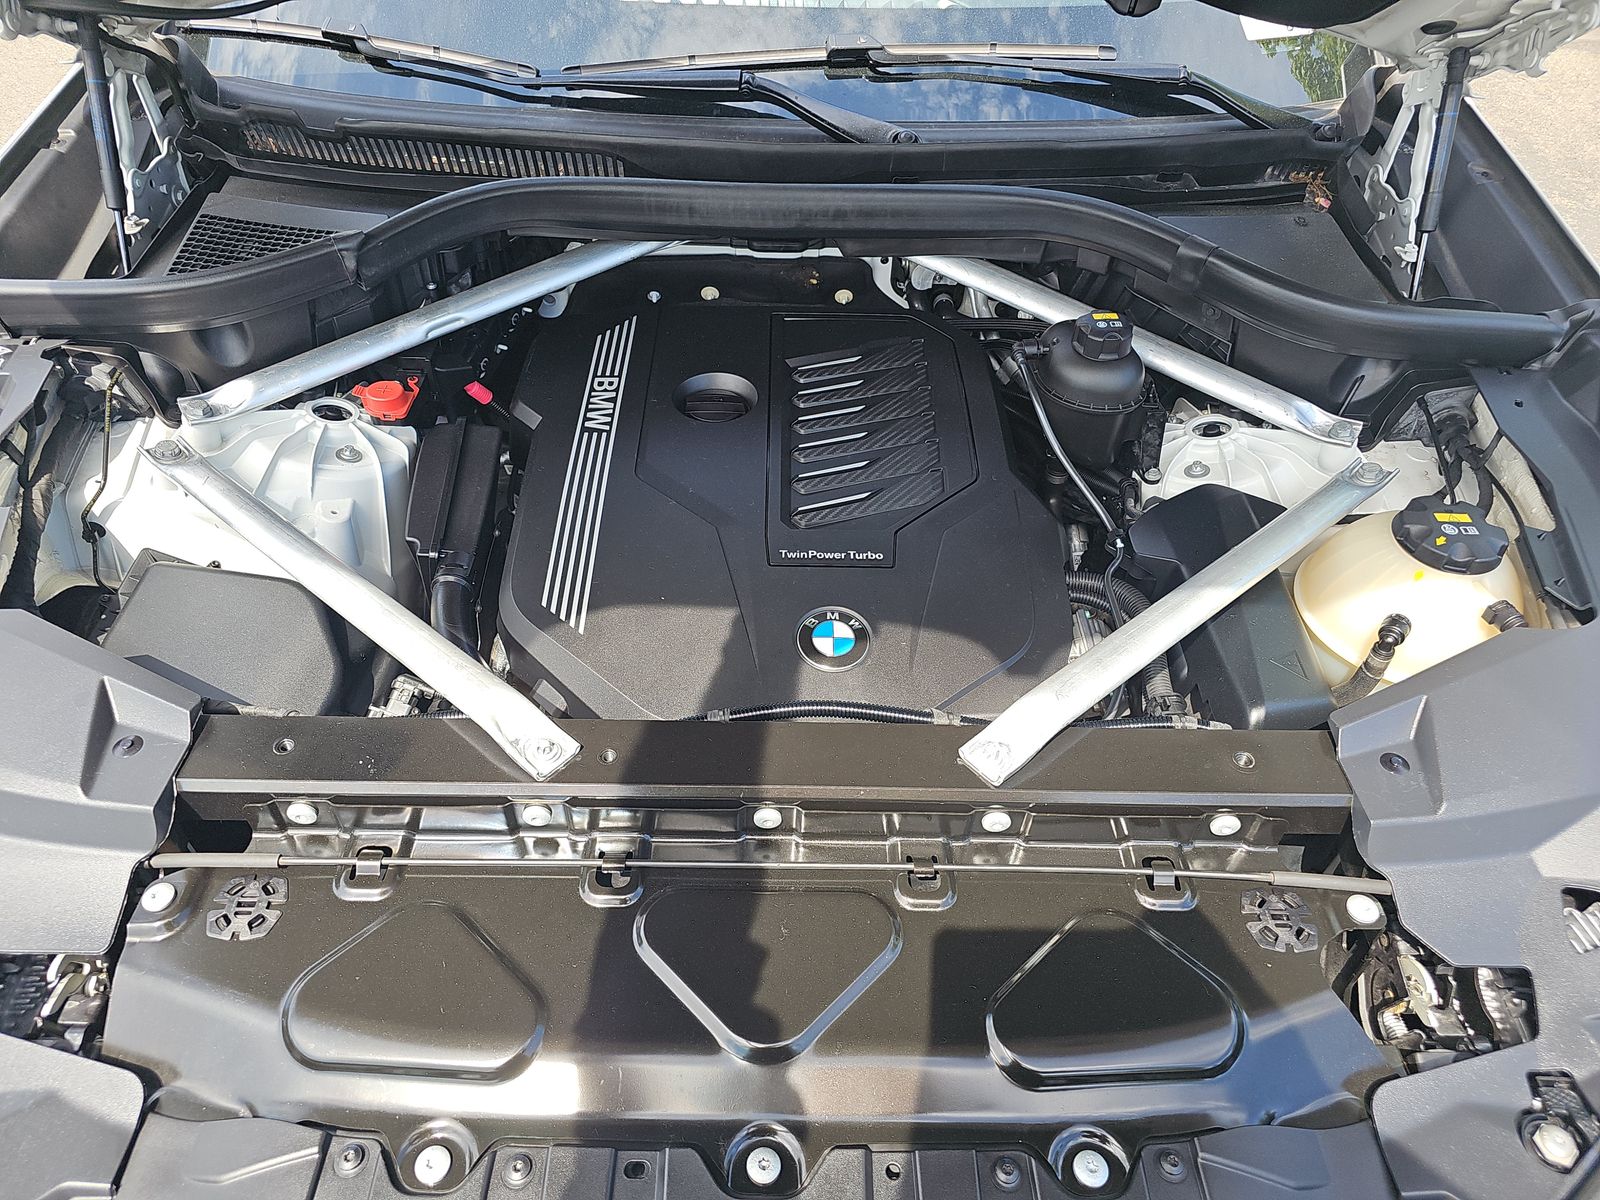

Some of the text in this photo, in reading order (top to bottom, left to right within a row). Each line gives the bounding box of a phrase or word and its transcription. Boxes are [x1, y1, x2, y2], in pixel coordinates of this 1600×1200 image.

[584, 377, 619, 431] BMW
[847, 550, 884, 560] Turbo
[805, 611, 862, 630] BMW
